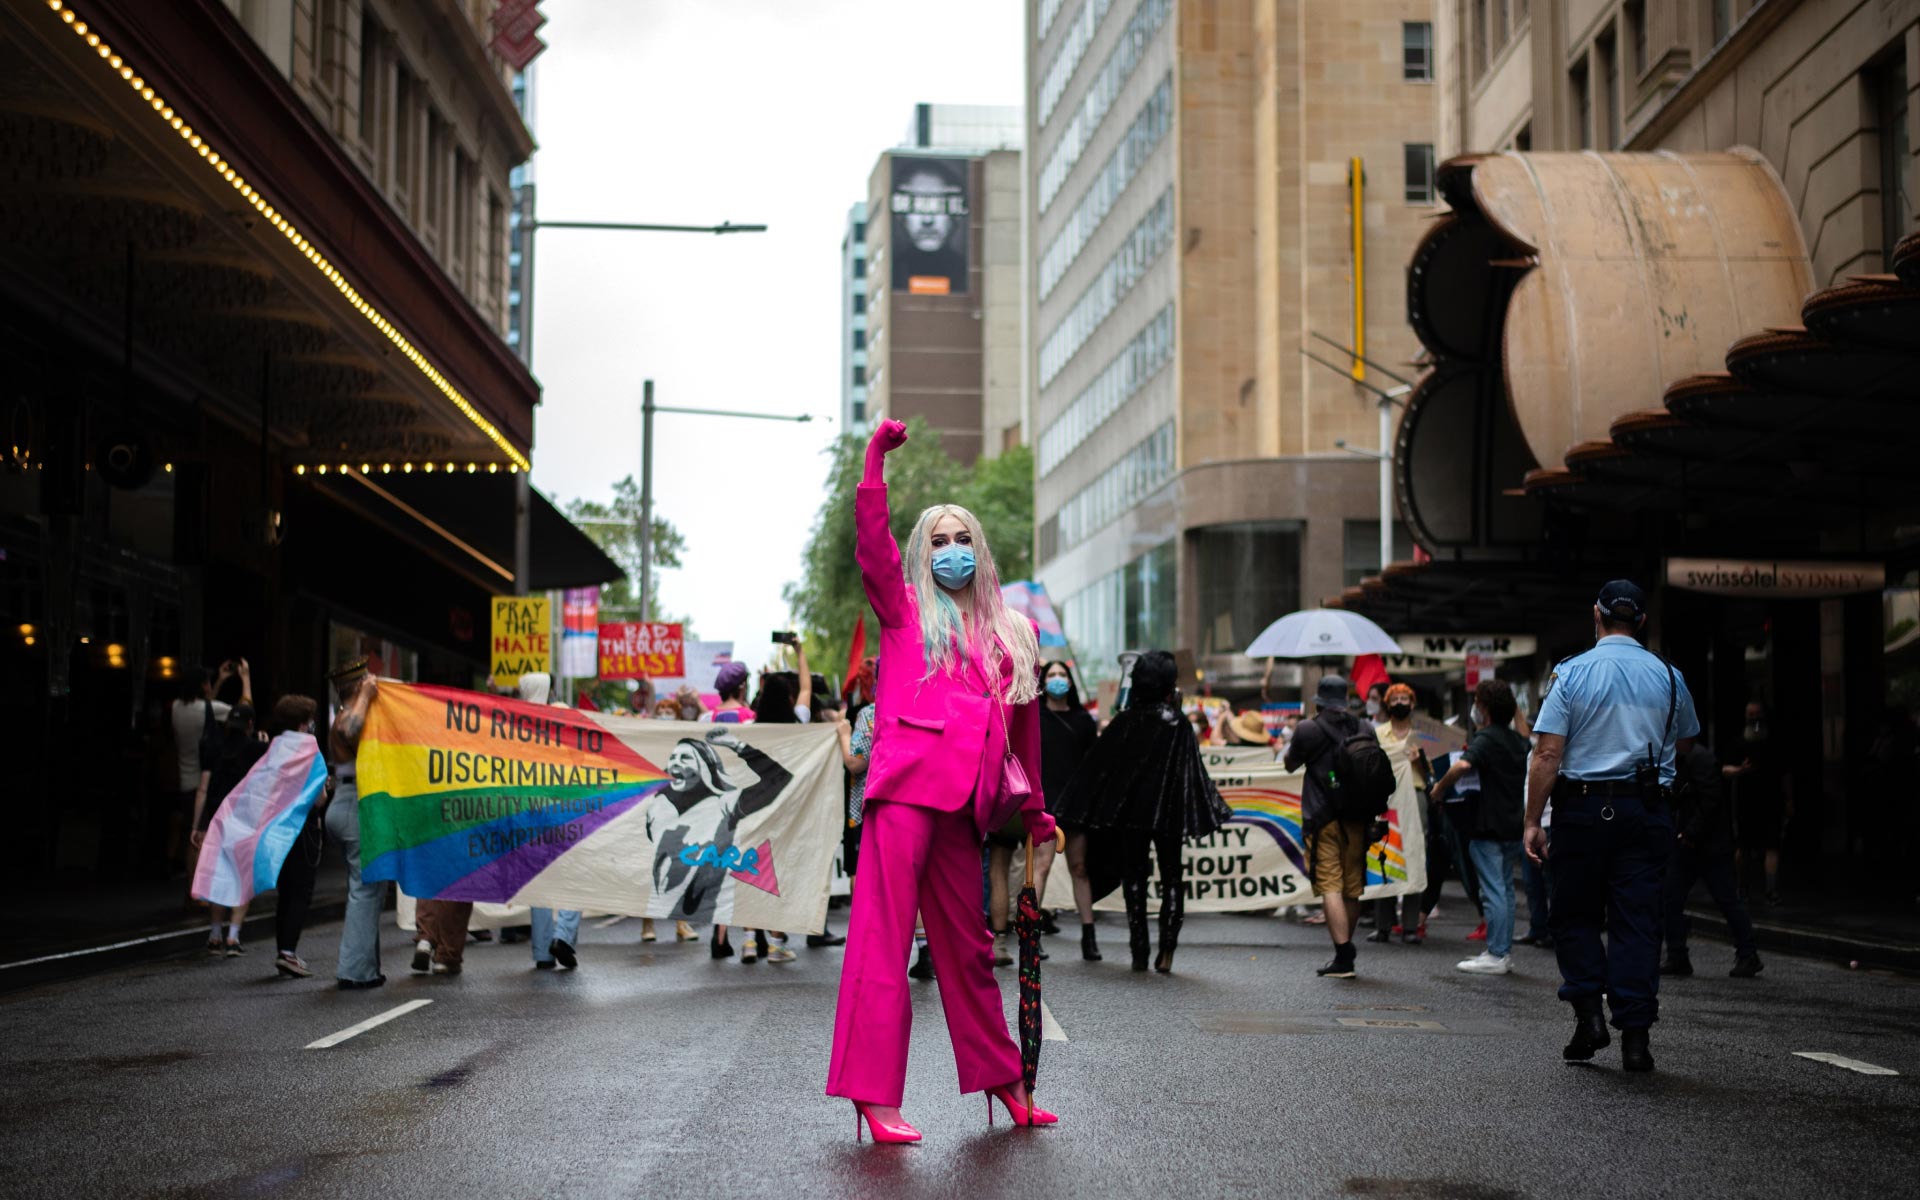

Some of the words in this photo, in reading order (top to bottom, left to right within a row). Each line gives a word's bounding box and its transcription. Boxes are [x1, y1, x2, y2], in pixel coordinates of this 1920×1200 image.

[1687, 563, 1777, 587] swissôtel
[1781, 572, 1864, 589] SYDNEY
[496, 602, 544, 620] PRAY
[505, 620, 539, 634] THE
[624, 624, 669, 642] BAD
[495, 633, 550, 655] HATE
[601, 639, 681, 656] THEOLOGY
[1424, 638, 1511, 652] MYR
[494, 658, 545, 676] AWAY
[446, 700, 482, 734] NO
[490, 709, 566, 747] RIGHT
[572, 726, 603, 753] TO
[429, 749, 619, 790] DISCRIMINATE!
[441, 794, 522, 823] EQUALITY
[527, 796, 604, 816] WITHOUT
[467, 823, 584, 858] EXEMPTIONS!
[679, 843, 760, 875] CARR
